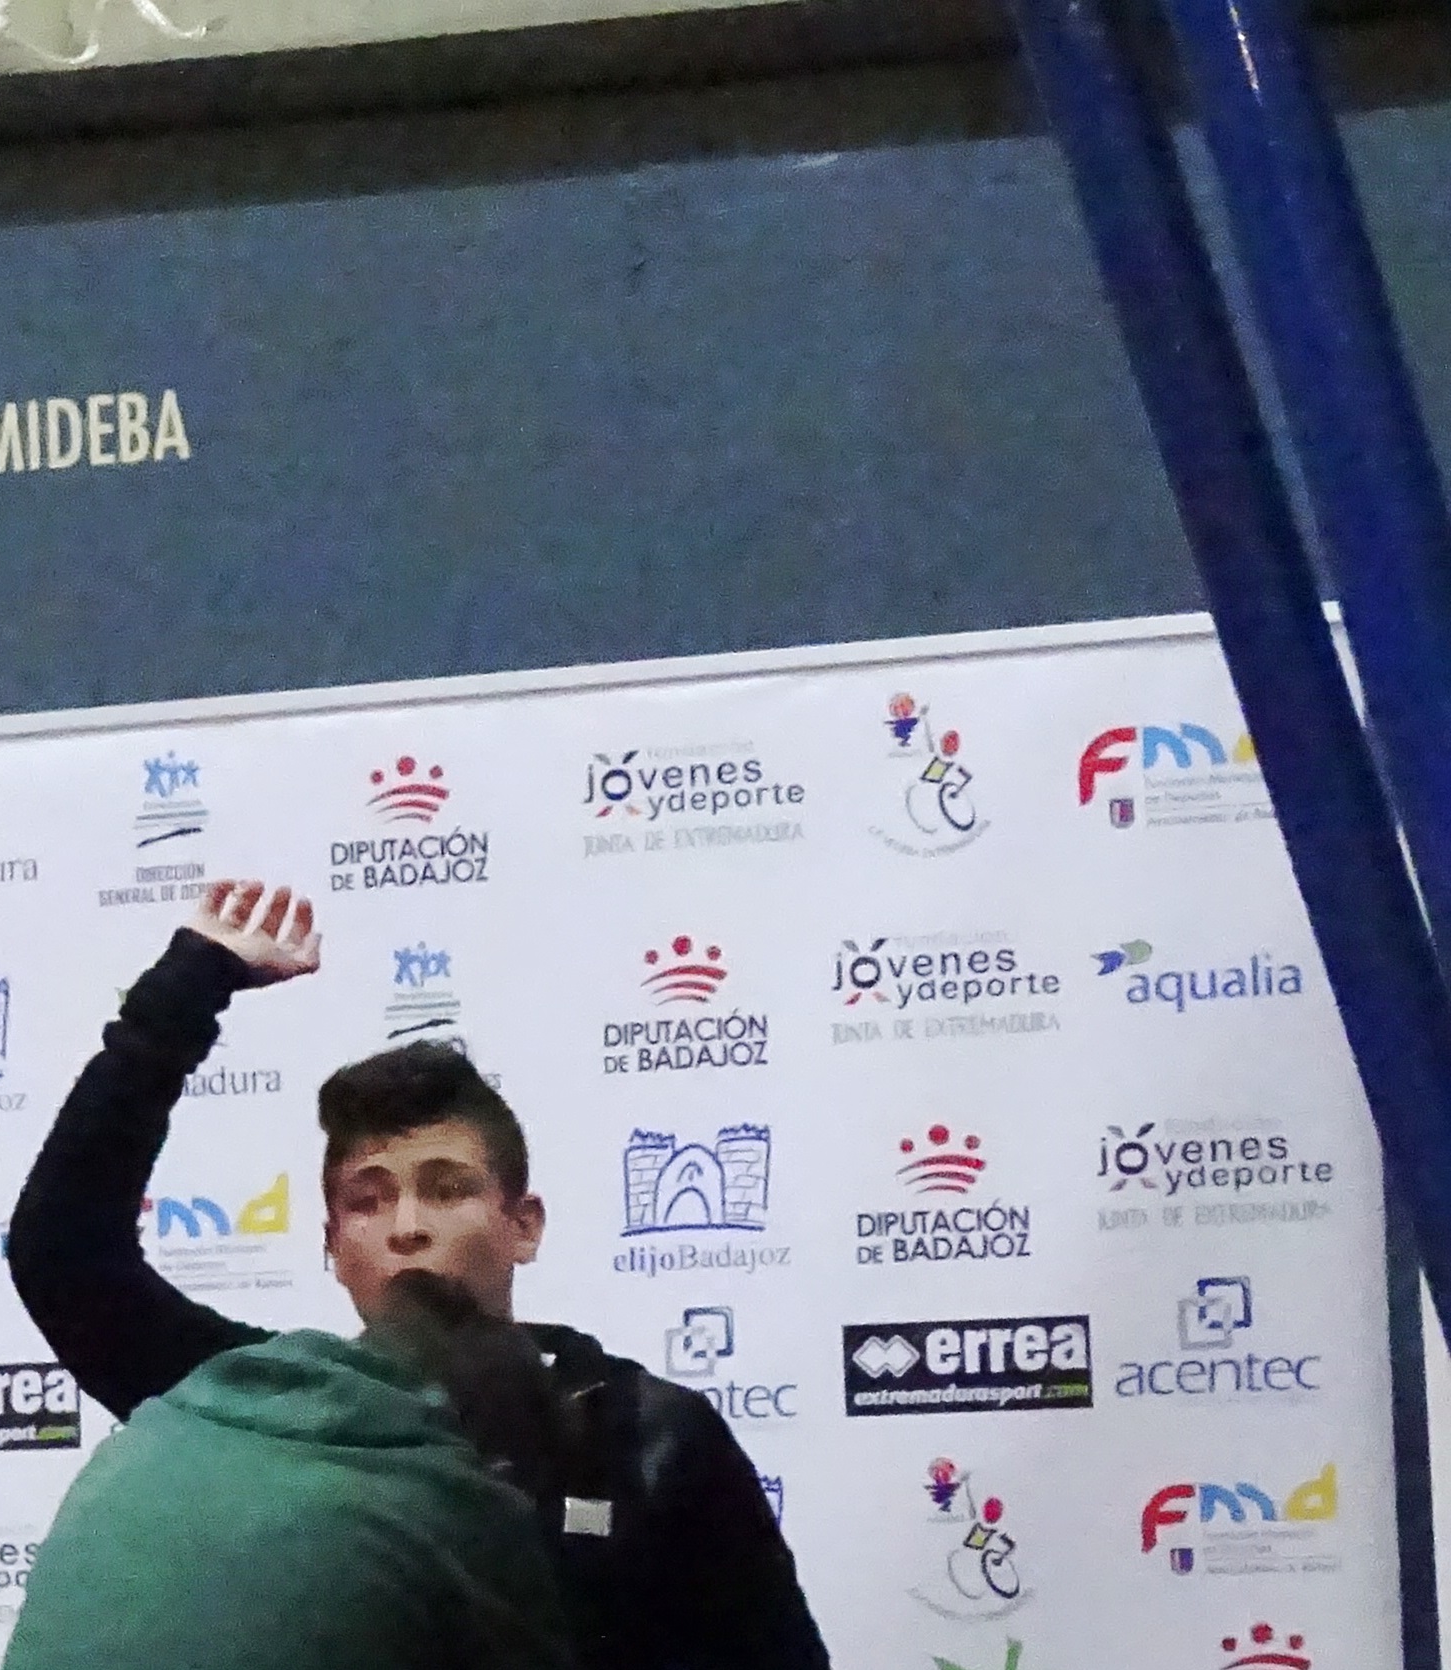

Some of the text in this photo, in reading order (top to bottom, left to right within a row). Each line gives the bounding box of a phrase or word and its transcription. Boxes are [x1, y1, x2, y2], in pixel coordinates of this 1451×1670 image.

[1078, 722, 1257, 806] fm
[647, 783, 806, 822] ydeporte
[330, 825, 489, 867] DIPUTACIÓN
[330, 856, 489, 891] DE BADAJOZ
[896, 973, 1061, 1010] ydeporte
[1125, 953, 1303, 1012] aqualia
[604, 1008, 769, 1047] DIPUTACIÓN
[604, 1040, 769, 1074] DE BADAJOZ
[1165, 1160, 1333, 1197] ydeporte
[857, 1199, 1030, 1238] DIPUTACIÓN
[857, 1231, 1031, 1264] DE BADAJOZ
[925, 1324, 1088, 1376] errea
[1116, 1353, 1322, 1398] acentec
